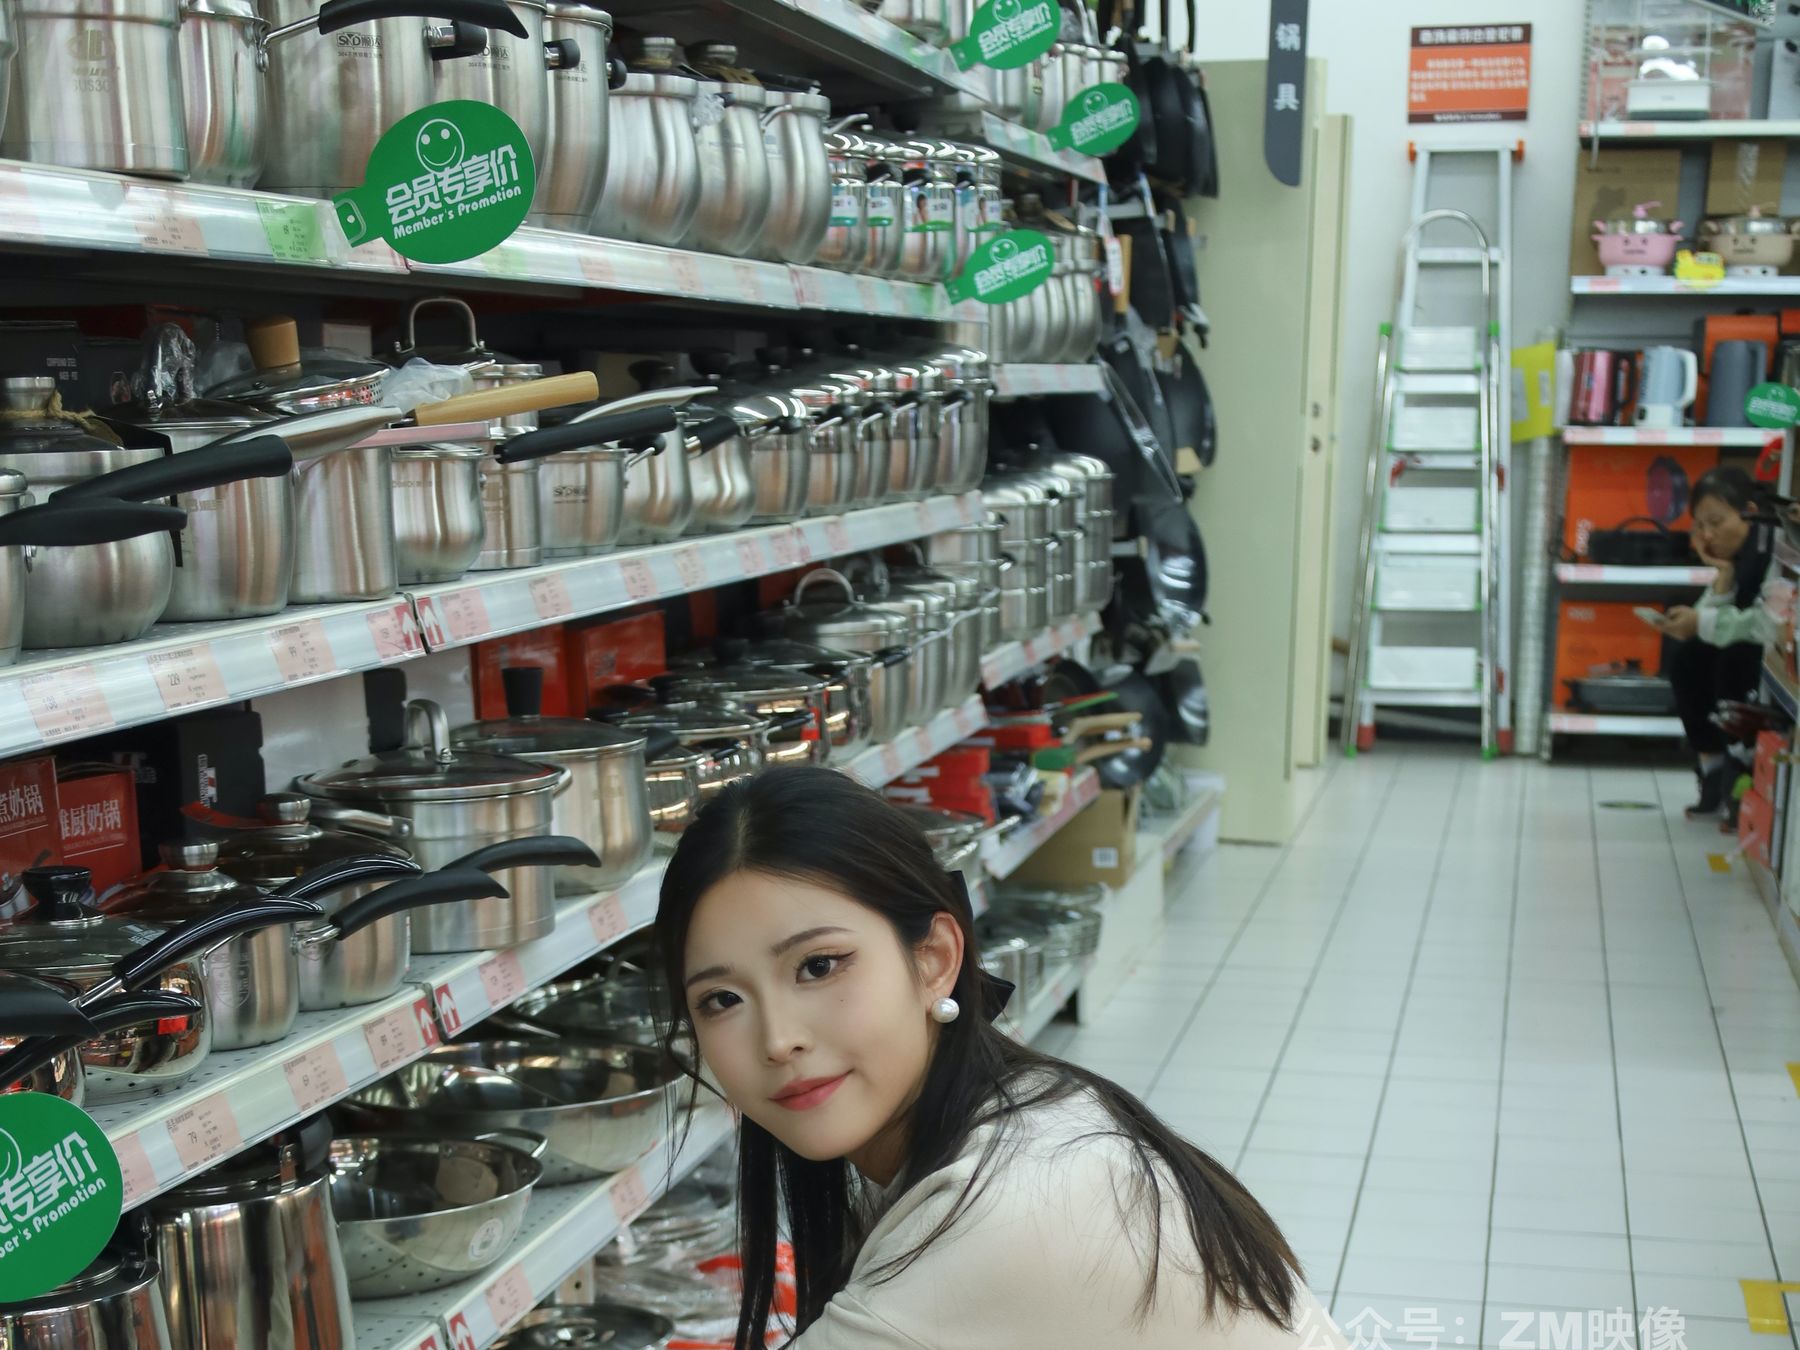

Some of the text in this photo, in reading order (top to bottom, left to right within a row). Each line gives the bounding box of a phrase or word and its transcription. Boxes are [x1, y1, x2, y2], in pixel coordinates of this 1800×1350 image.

[1273, 22, 1300, 111] 锅具
[386, 144, 519, 225] 会员专享价
[393, 186, 521, 239] Member's Promotion
[0, 1131, 98, 1233] 专享价
[32, 1177, 106, 1233] Promotion
